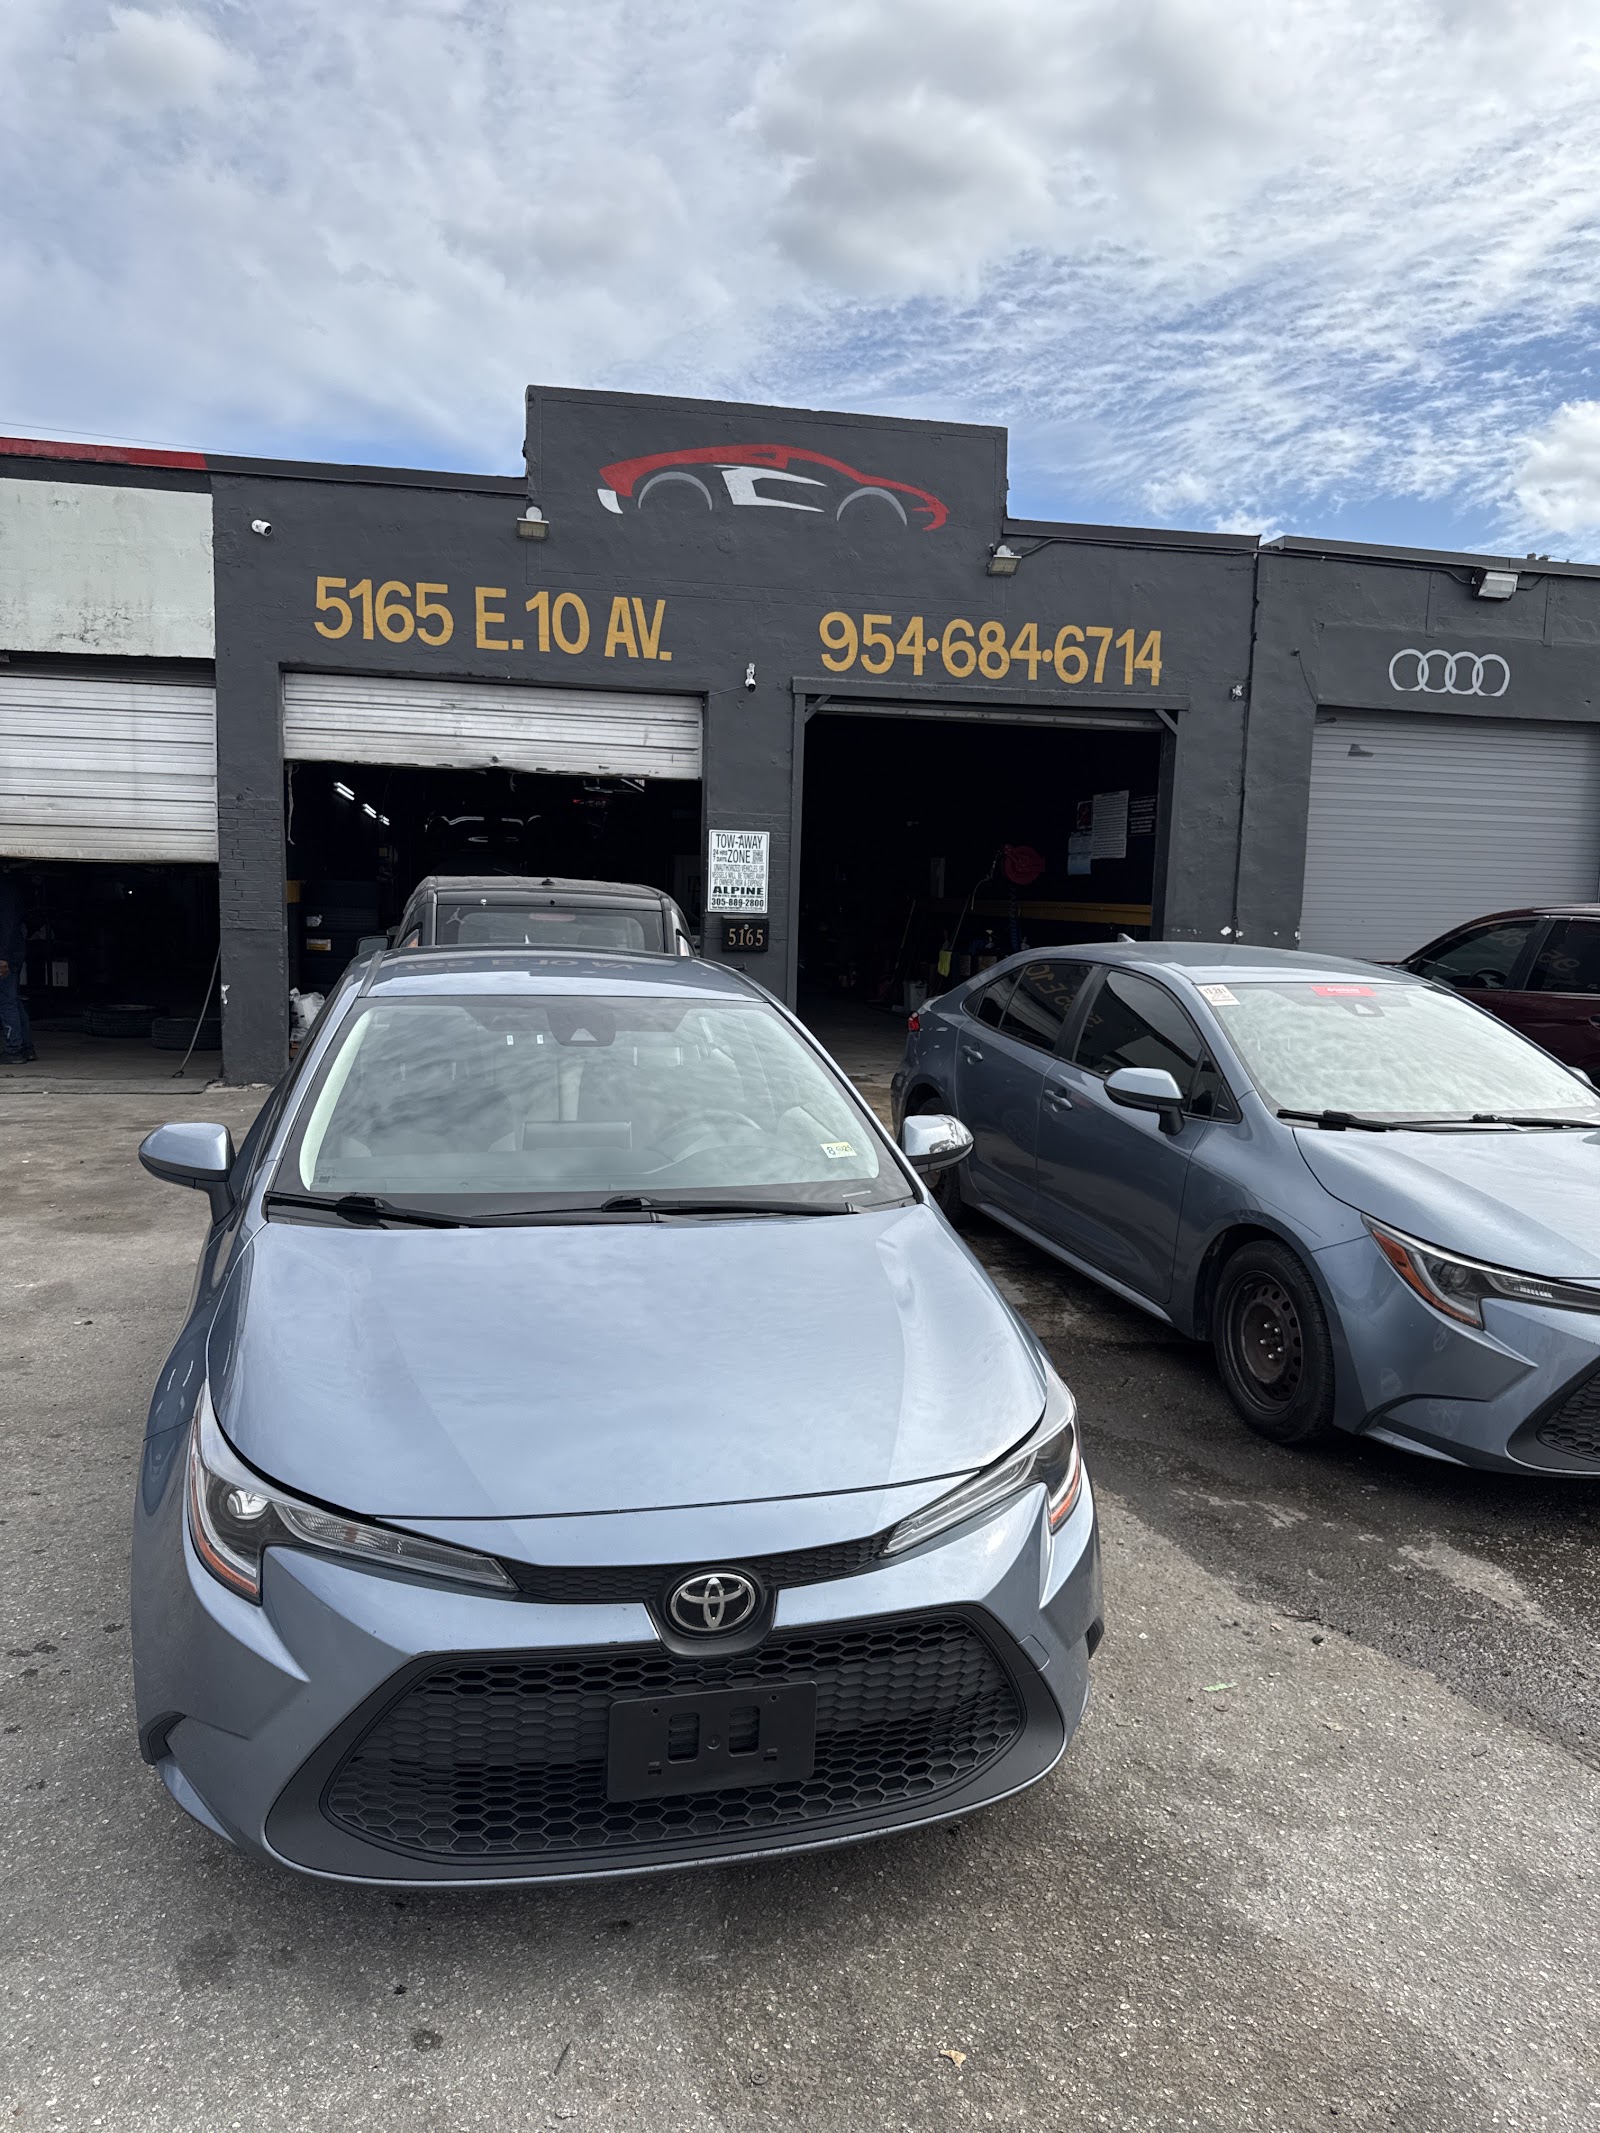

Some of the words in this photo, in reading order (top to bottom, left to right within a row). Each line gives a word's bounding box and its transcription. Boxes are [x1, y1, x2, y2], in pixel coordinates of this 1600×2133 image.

[314, 576, 454, 646] 5165
[604, 597, 672, 661] AV.
[716, 833, 763, 849] TOW-AWAY
[728, 849, 751, 863] ZONE
[713, 886, 764, 896] ALPINE
[711, 898, 764, 907] 305-889-2800
[728, 928, 764, 947] 5165
[827, 1146, 836, 1155] 8
